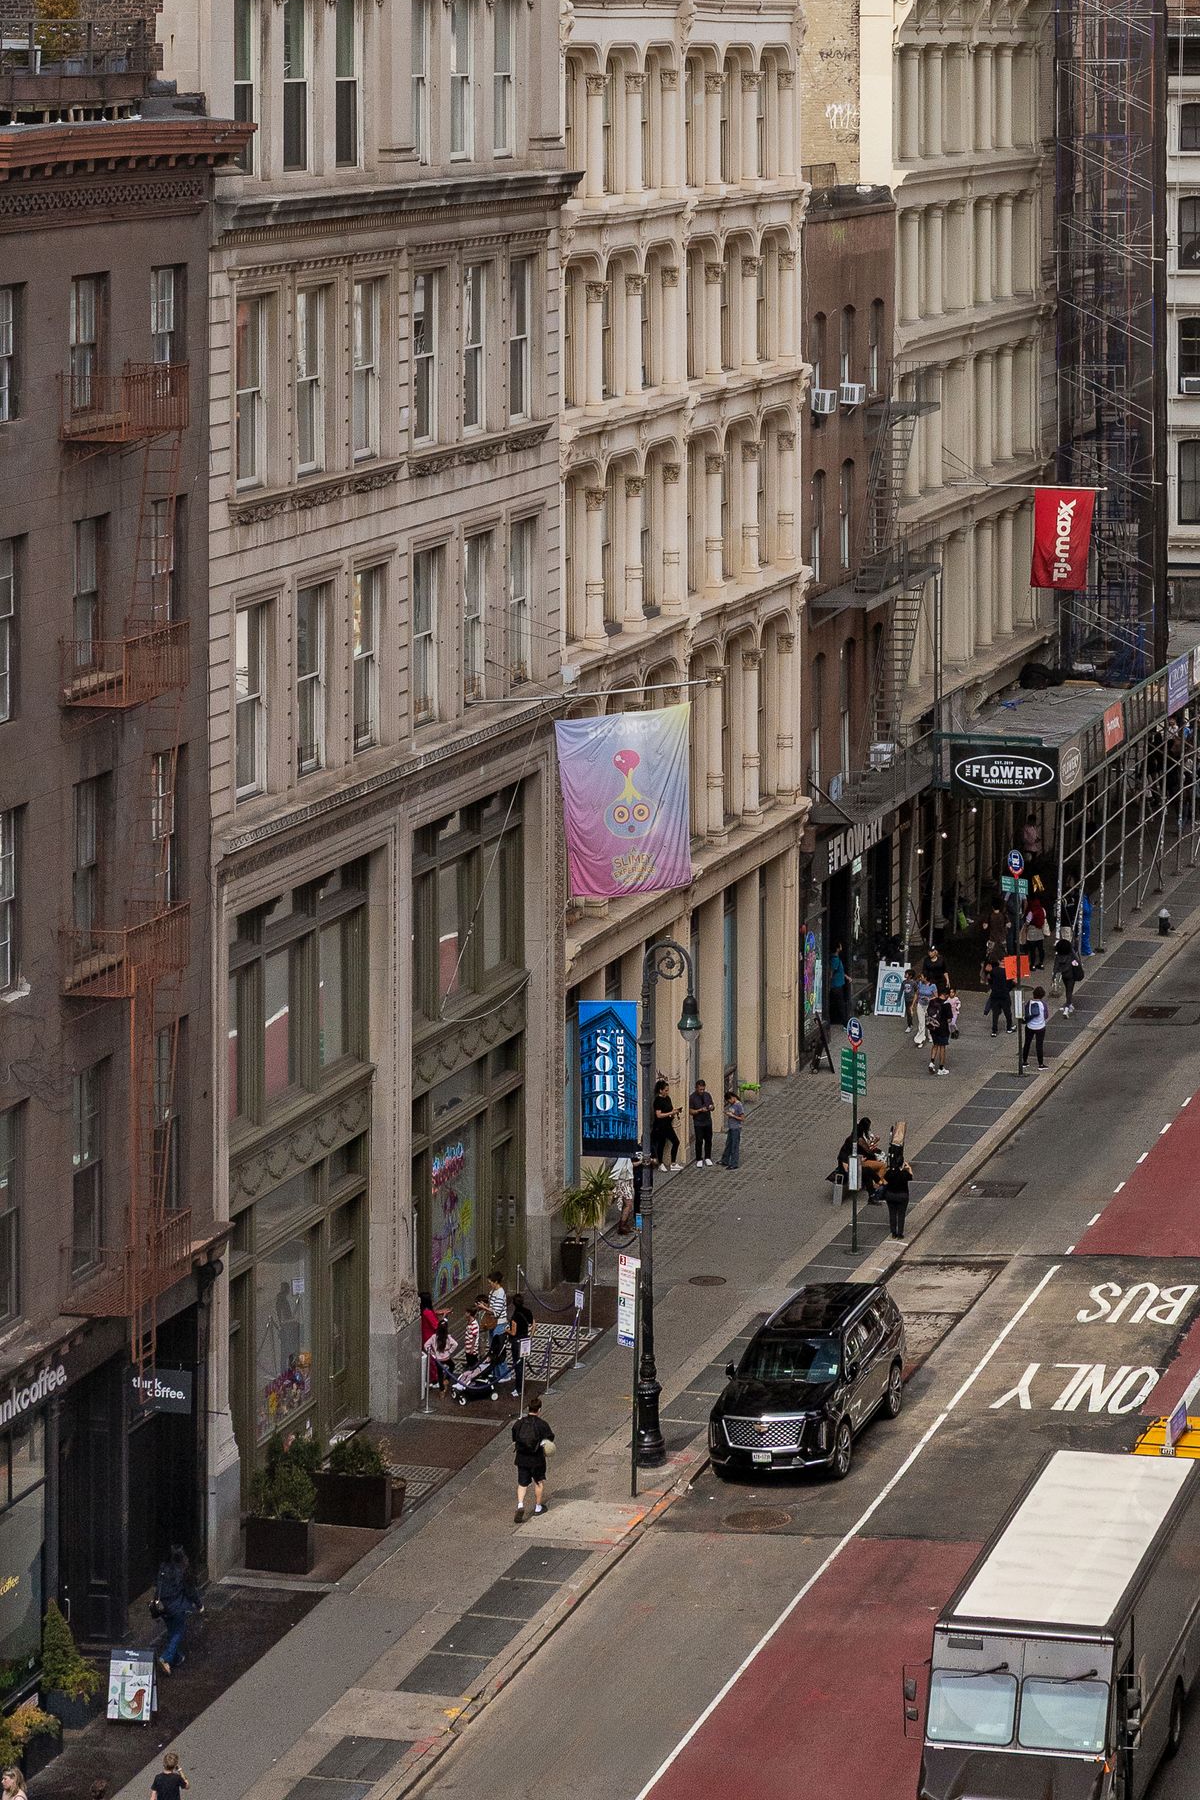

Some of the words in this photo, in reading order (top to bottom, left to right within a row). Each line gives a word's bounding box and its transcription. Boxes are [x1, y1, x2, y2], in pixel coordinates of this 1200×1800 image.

[972, 764, 1042, 779] FLOWERY
[594, 1035, 614, 1112] SOHO
[616, 1036, 625, 1111] BROADWAY
[1076, 1282, 1198, 1325] BUS
[132, 1377, 162, 1389] think
[989, 1363, 1160, 1414] ONLY
